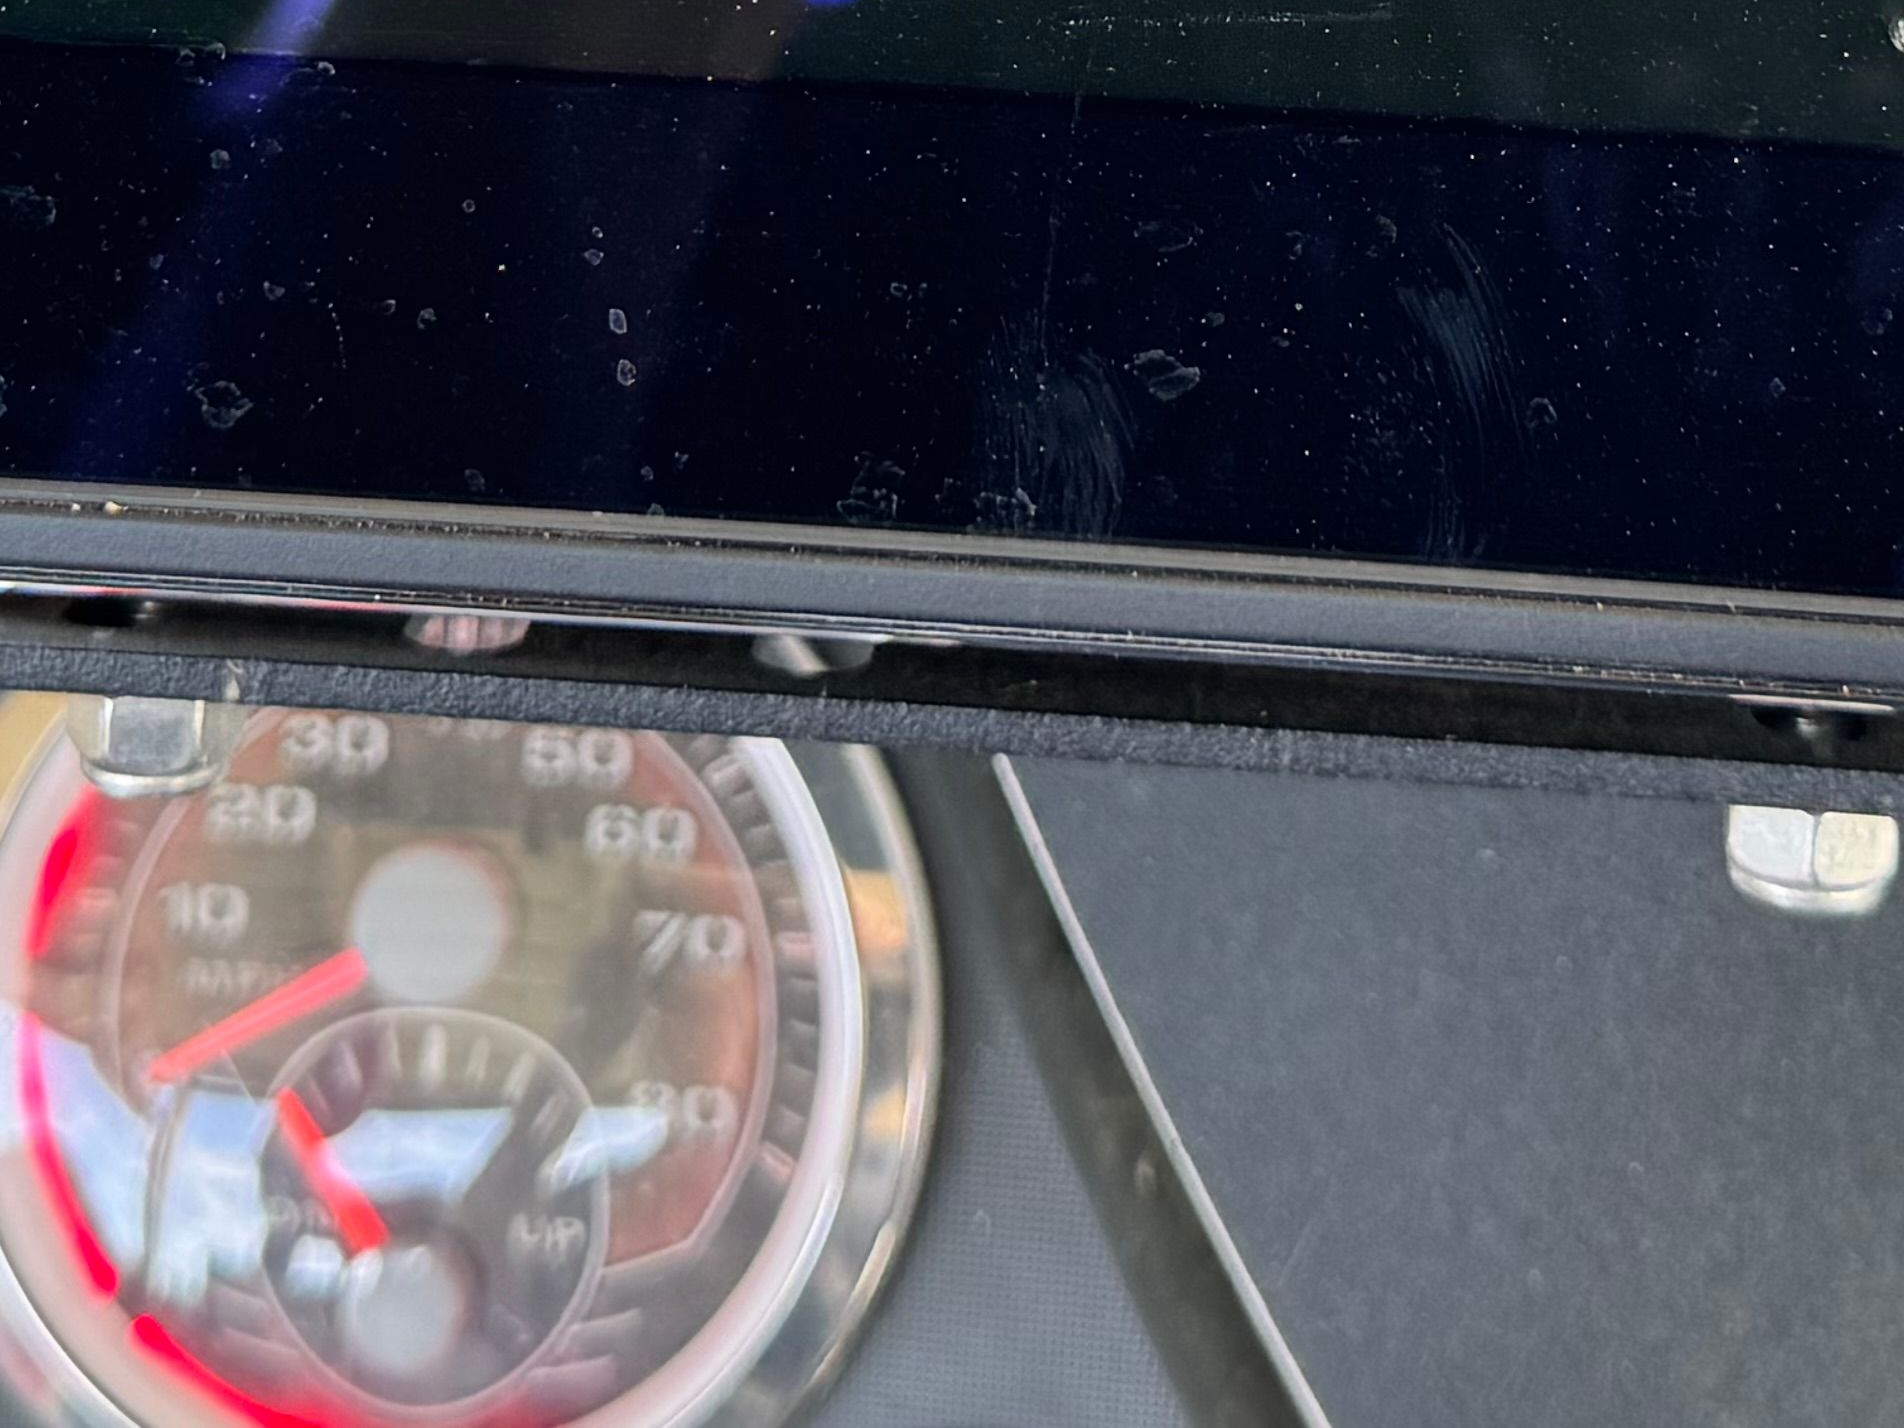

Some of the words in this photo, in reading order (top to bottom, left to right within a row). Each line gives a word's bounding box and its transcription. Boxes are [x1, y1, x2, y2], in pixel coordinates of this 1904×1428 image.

[280, 715, 390, 776] 30
[521, 727, 635, 790] 50
[204, 783, 316, 842] 20
[585, 803, 698, 866] 60
[159, 882, 248, 938] 10
[634, 908, 746, 974] 70
